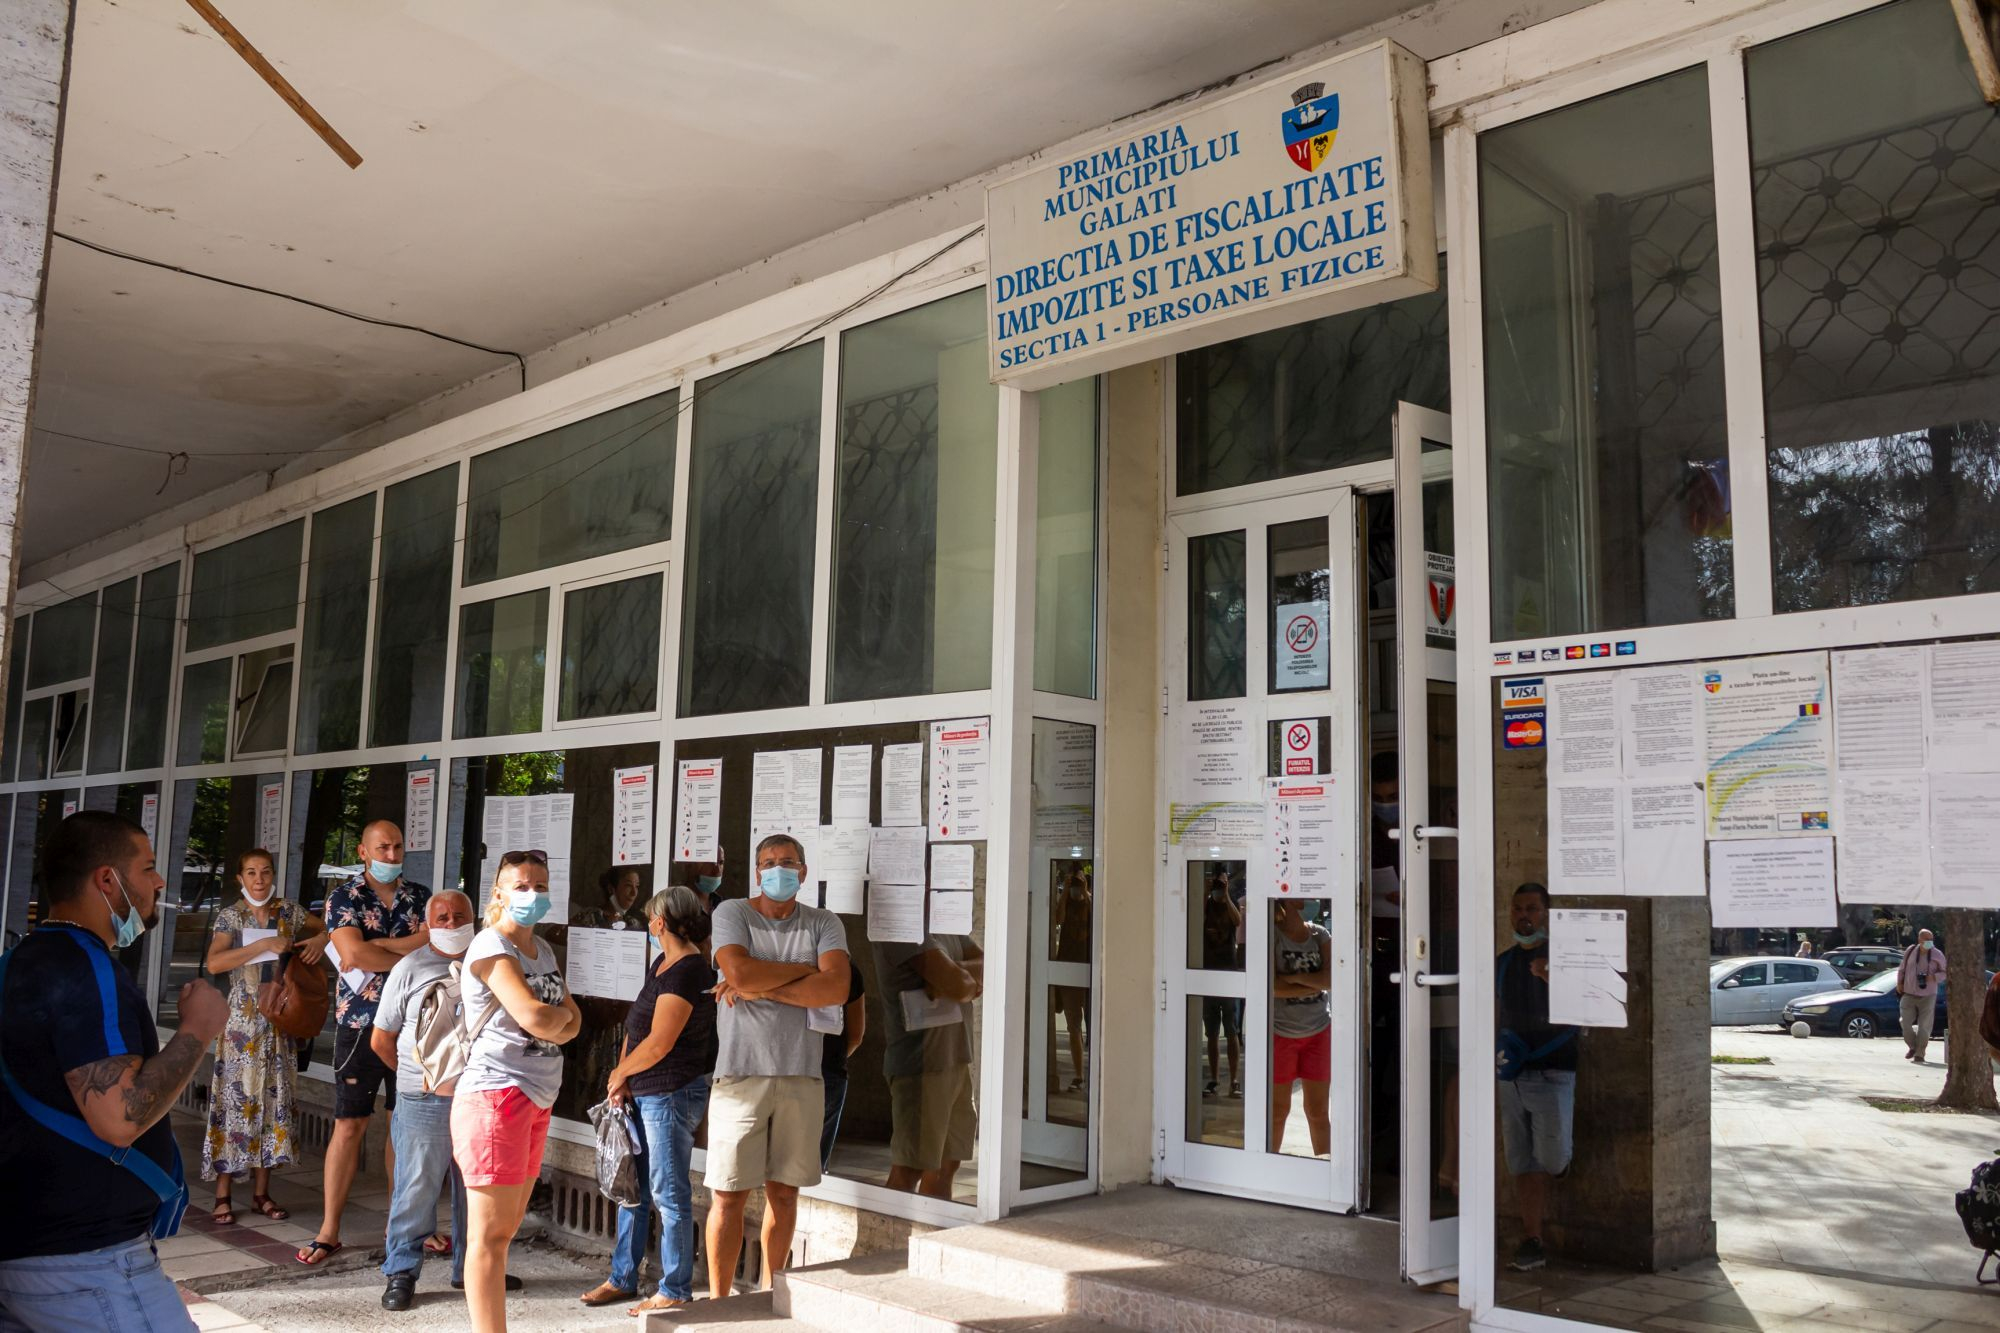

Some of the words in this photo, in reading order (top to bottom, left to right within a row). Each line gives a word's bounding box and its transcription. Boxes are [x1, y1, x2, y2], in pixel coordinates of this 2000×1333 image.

[1044, 130, 1240, 222] MUNICIPIULUI
[1058, 124, 1189, 190] PRIMARIA
[995, 241, 1121, 304] DIRECTIA
[1129, 223, 1168, 261] DE
[1176, 155, 1386, 248] FISCALITATE
[1079, 184, 1176, 236] GALATI
[997, 276, 1126, 341] IMPOZITE
[1132, 266, 1159, 300] SI
[1165, 241, 1245, 289] TAXE
[1253, 200, 1387, 267] LOCALE
[999, 328, 1089, 369] SECTIA
[1096, 322, 1105, 342] 1
[1128, 276, 1270, 333] PERSOANE
[1281, 246, 1385, 294] FIZICE
[1504, 712, 1544, 720] EUROCARD
[1511, 686, 1538, 698] VISA
